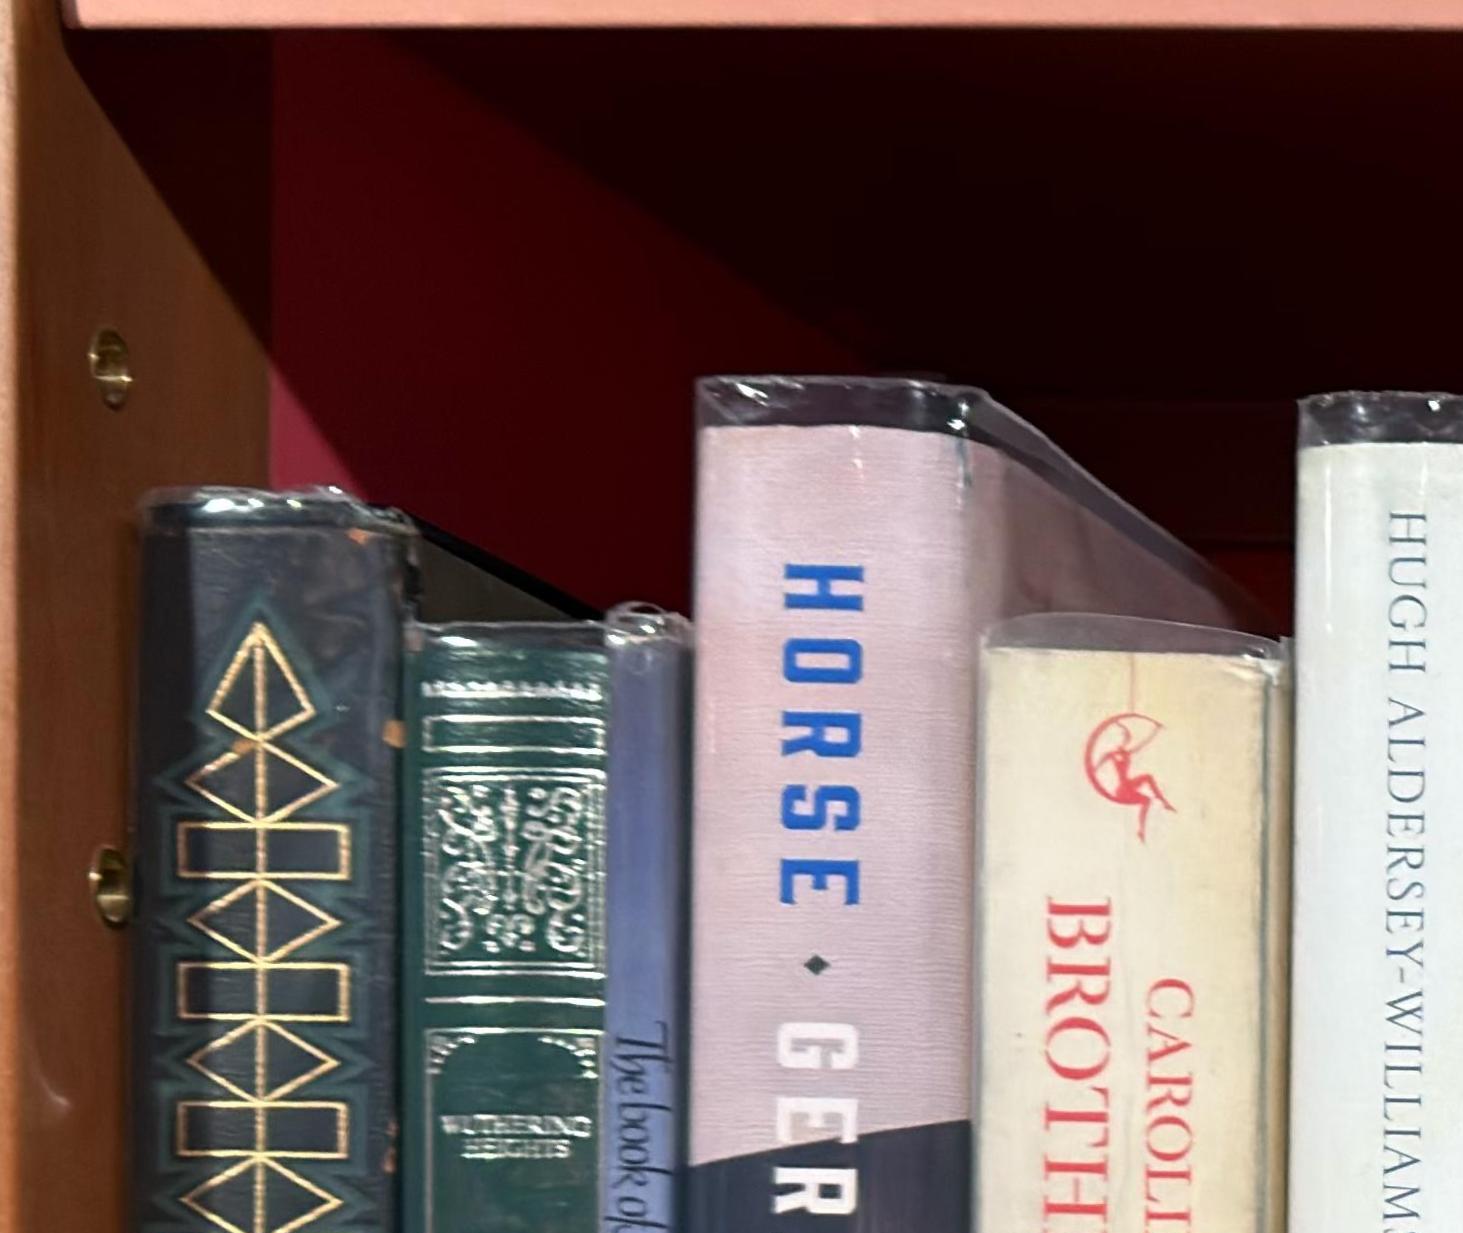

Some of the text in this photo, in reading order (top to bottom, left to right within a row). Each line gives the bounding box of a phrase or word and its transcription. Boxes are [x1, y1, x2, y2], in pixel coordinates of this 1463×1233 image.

[1384, 510, 1429, 676] HUGH
[780, 563, 865, 907] HORSE
[610, 1021, 674, 1094] The
[440, 1114, 592, 1138] WUTHERING
[461, 1138, 572, 1159] HEIGHTS
[611, 1102, 674, 1189] book
[604, 1196, 671, 1228] of
